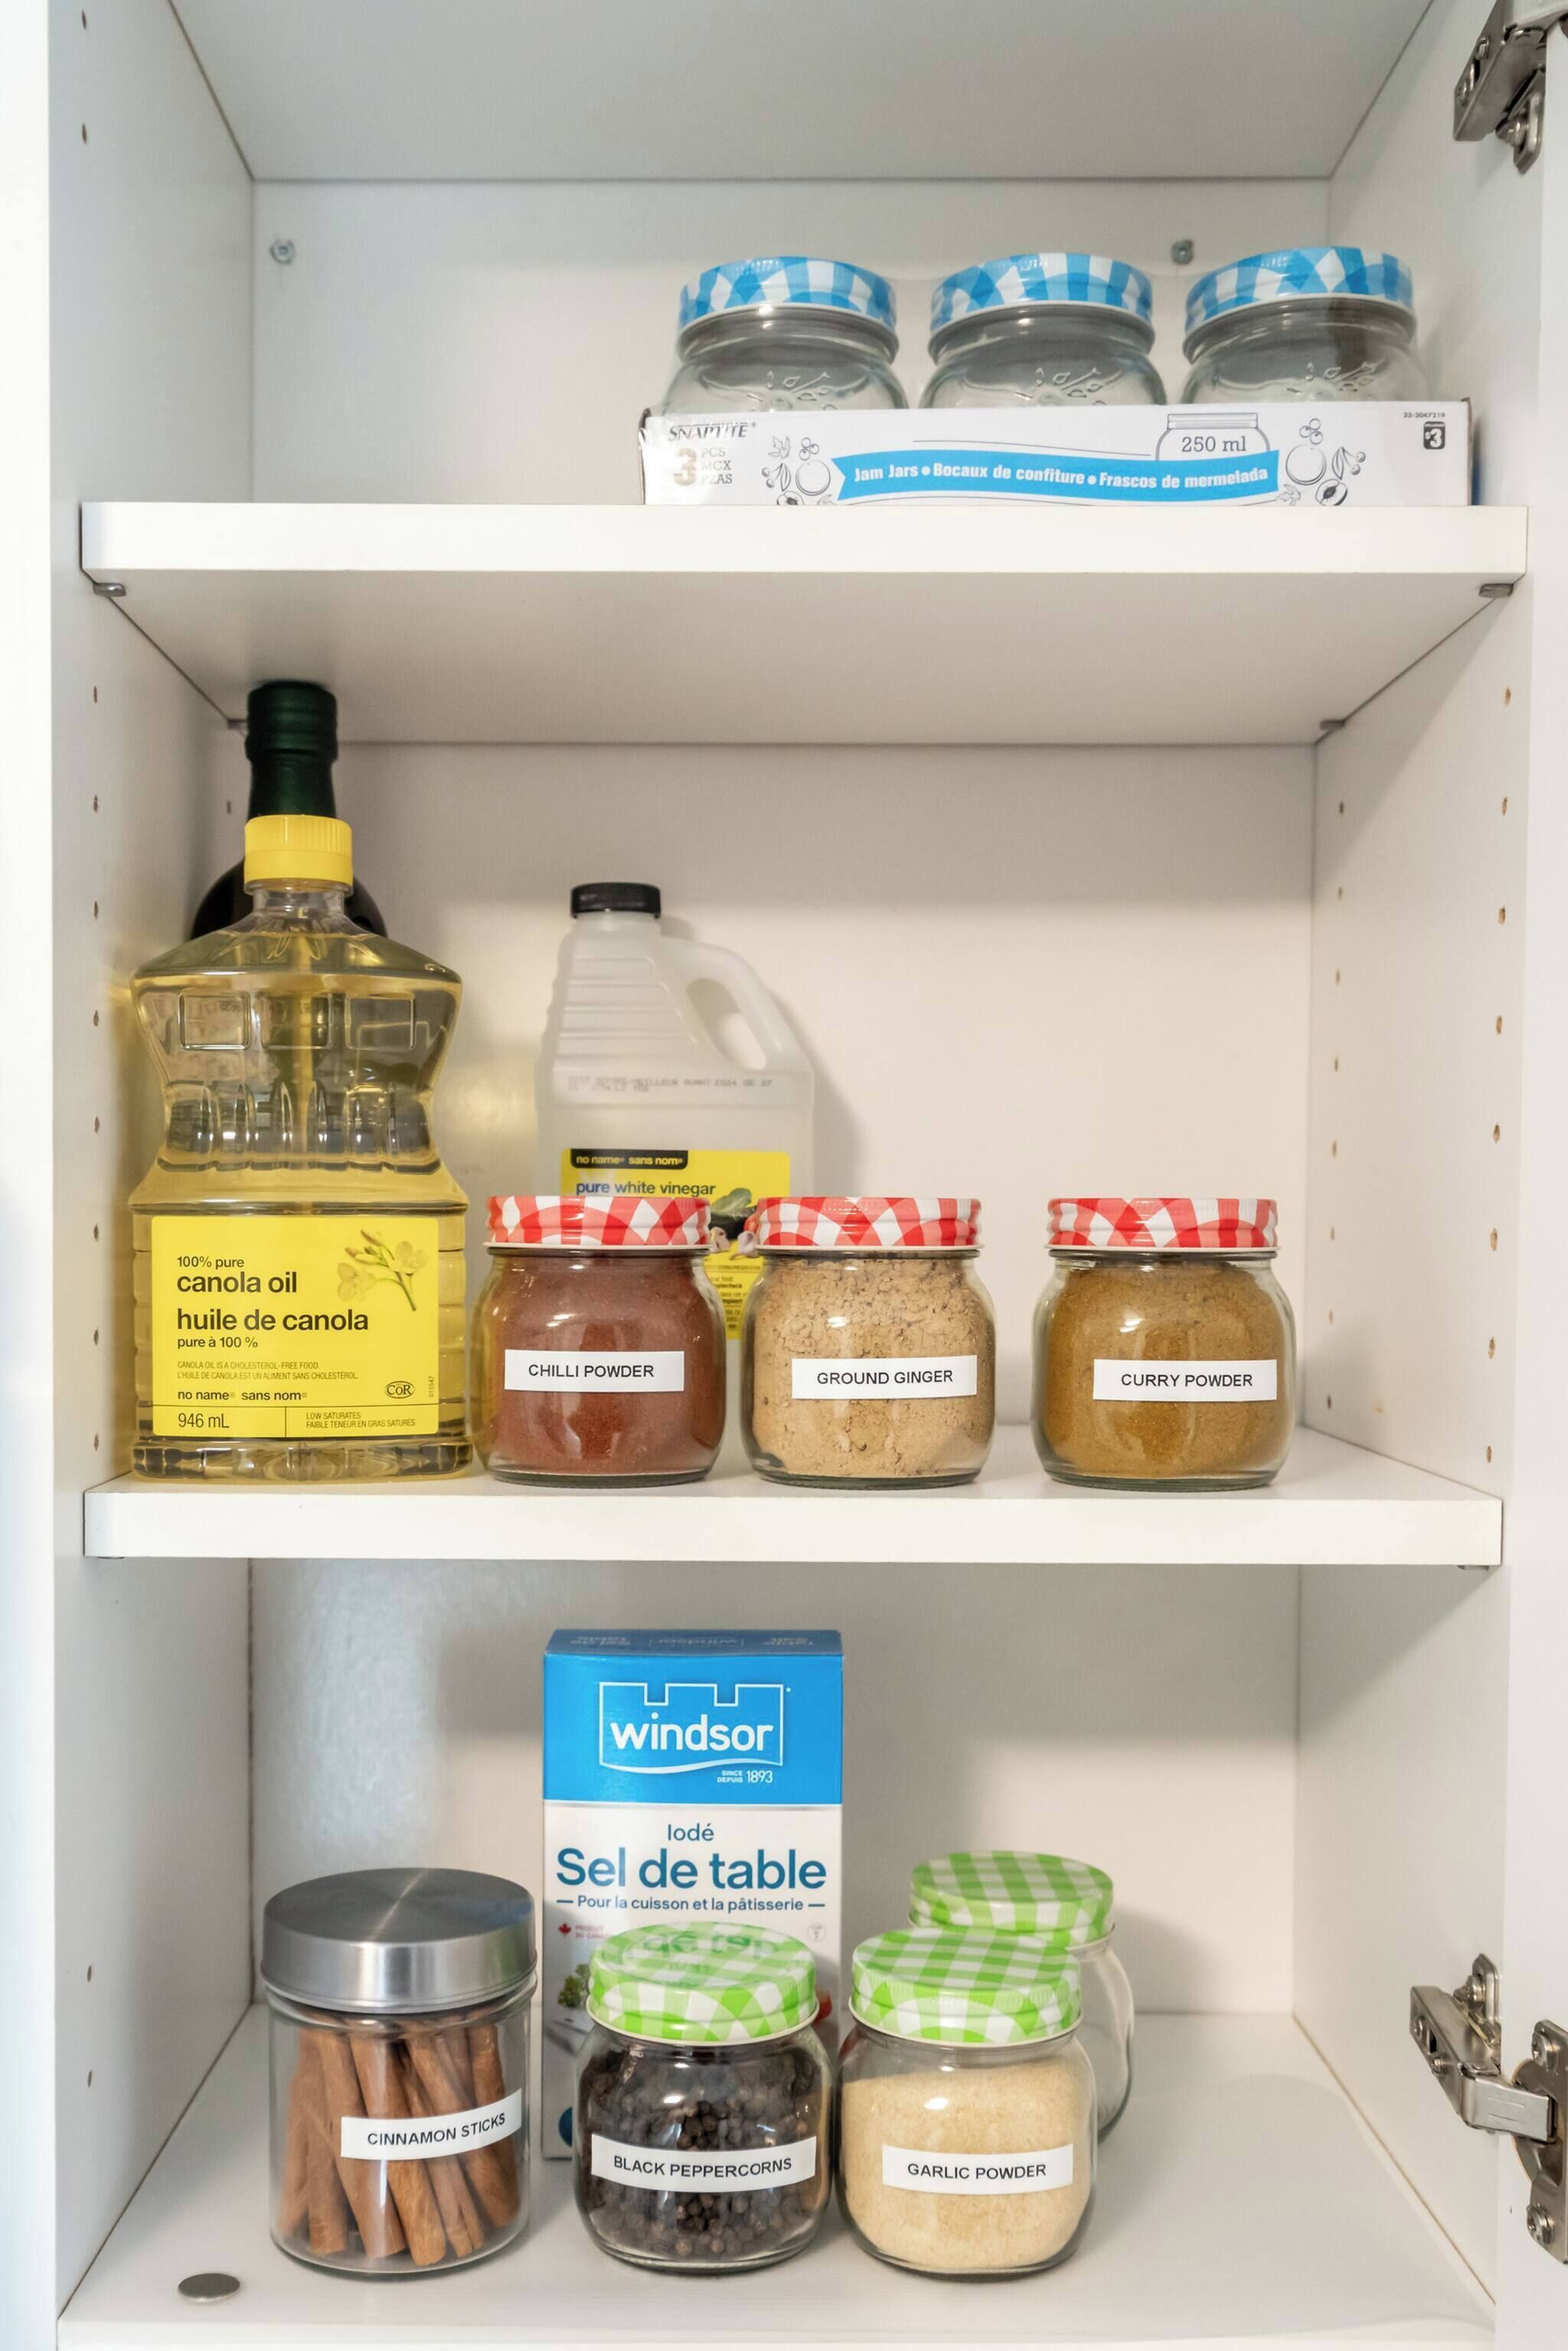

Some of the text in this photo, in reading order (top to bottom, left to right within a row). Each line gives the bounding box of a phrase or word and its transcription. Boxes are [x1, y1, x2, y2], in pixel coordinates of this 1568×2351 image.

[1181, 436, 1246, 452] 250 ml
[701, 447, 726, 459] PCS
[674, 447, 697, 487] 3
[701, 460, 732, 471] MCX
[701, 474, 733, 485] PZAS
[854, 462, 1269, 488] Jam Jars Bocaux de confiture Frascos de mermelada
[714, 1078, 737, 1086] 2024
[761, 1078, 773, 1087] 27
[577, 1156, 678, 1165] no name sans nom
[576, 1180, 716, 1197] pure white vinegar
[178, 1255, 245, 1270] 100% pure
[177, 1271, 297, 1293] canola oil
[178, 1308, 369, 1331] huile de canola
[178, 1336, 258, 1349] pure à 100 %
[178, 1361, 204, 1370] CANOLA
[205, 1361, 216, 1370] OIL
[216, 1361, 224, 1370] IS
[224, 1361, 229, 1370] A
[528, 1363, 654, 1378] CHILLI POWDER
[201, 1371, 210, 1380] DE
[211, 1371, 238, 1380] CANOLA
[239, 1371, 251, 1380] EST
[253, 1371, 262, 1380] UN
[263, 1371, 292, 1380] ALIMENT
[292, 1371, 309, 1380] SANS
[816, 1369, 953, 1386] GROUND GINGER
[1121, 1373, 1253, 1387] CURRY POWDER
[178, 1391, 302, 1401] no name sans nom
[178, 1412, 230, 1429] 946 mL
[610, 1712, 774, 1752] windsor
[746, 1770, 773, 1783] 1893
[556, 1847, 827, 1890] Sel de table
[577, 1894, 804, 1914] Pour la cuisson et la pâtisserie
[368, 2113, 506, 2146] CINNAMON STICKS
[614, 2155, 792, 2178] BLACK PEPPERCORNS
[906, 2163, 1047, 2180] GARLIC POWDER
